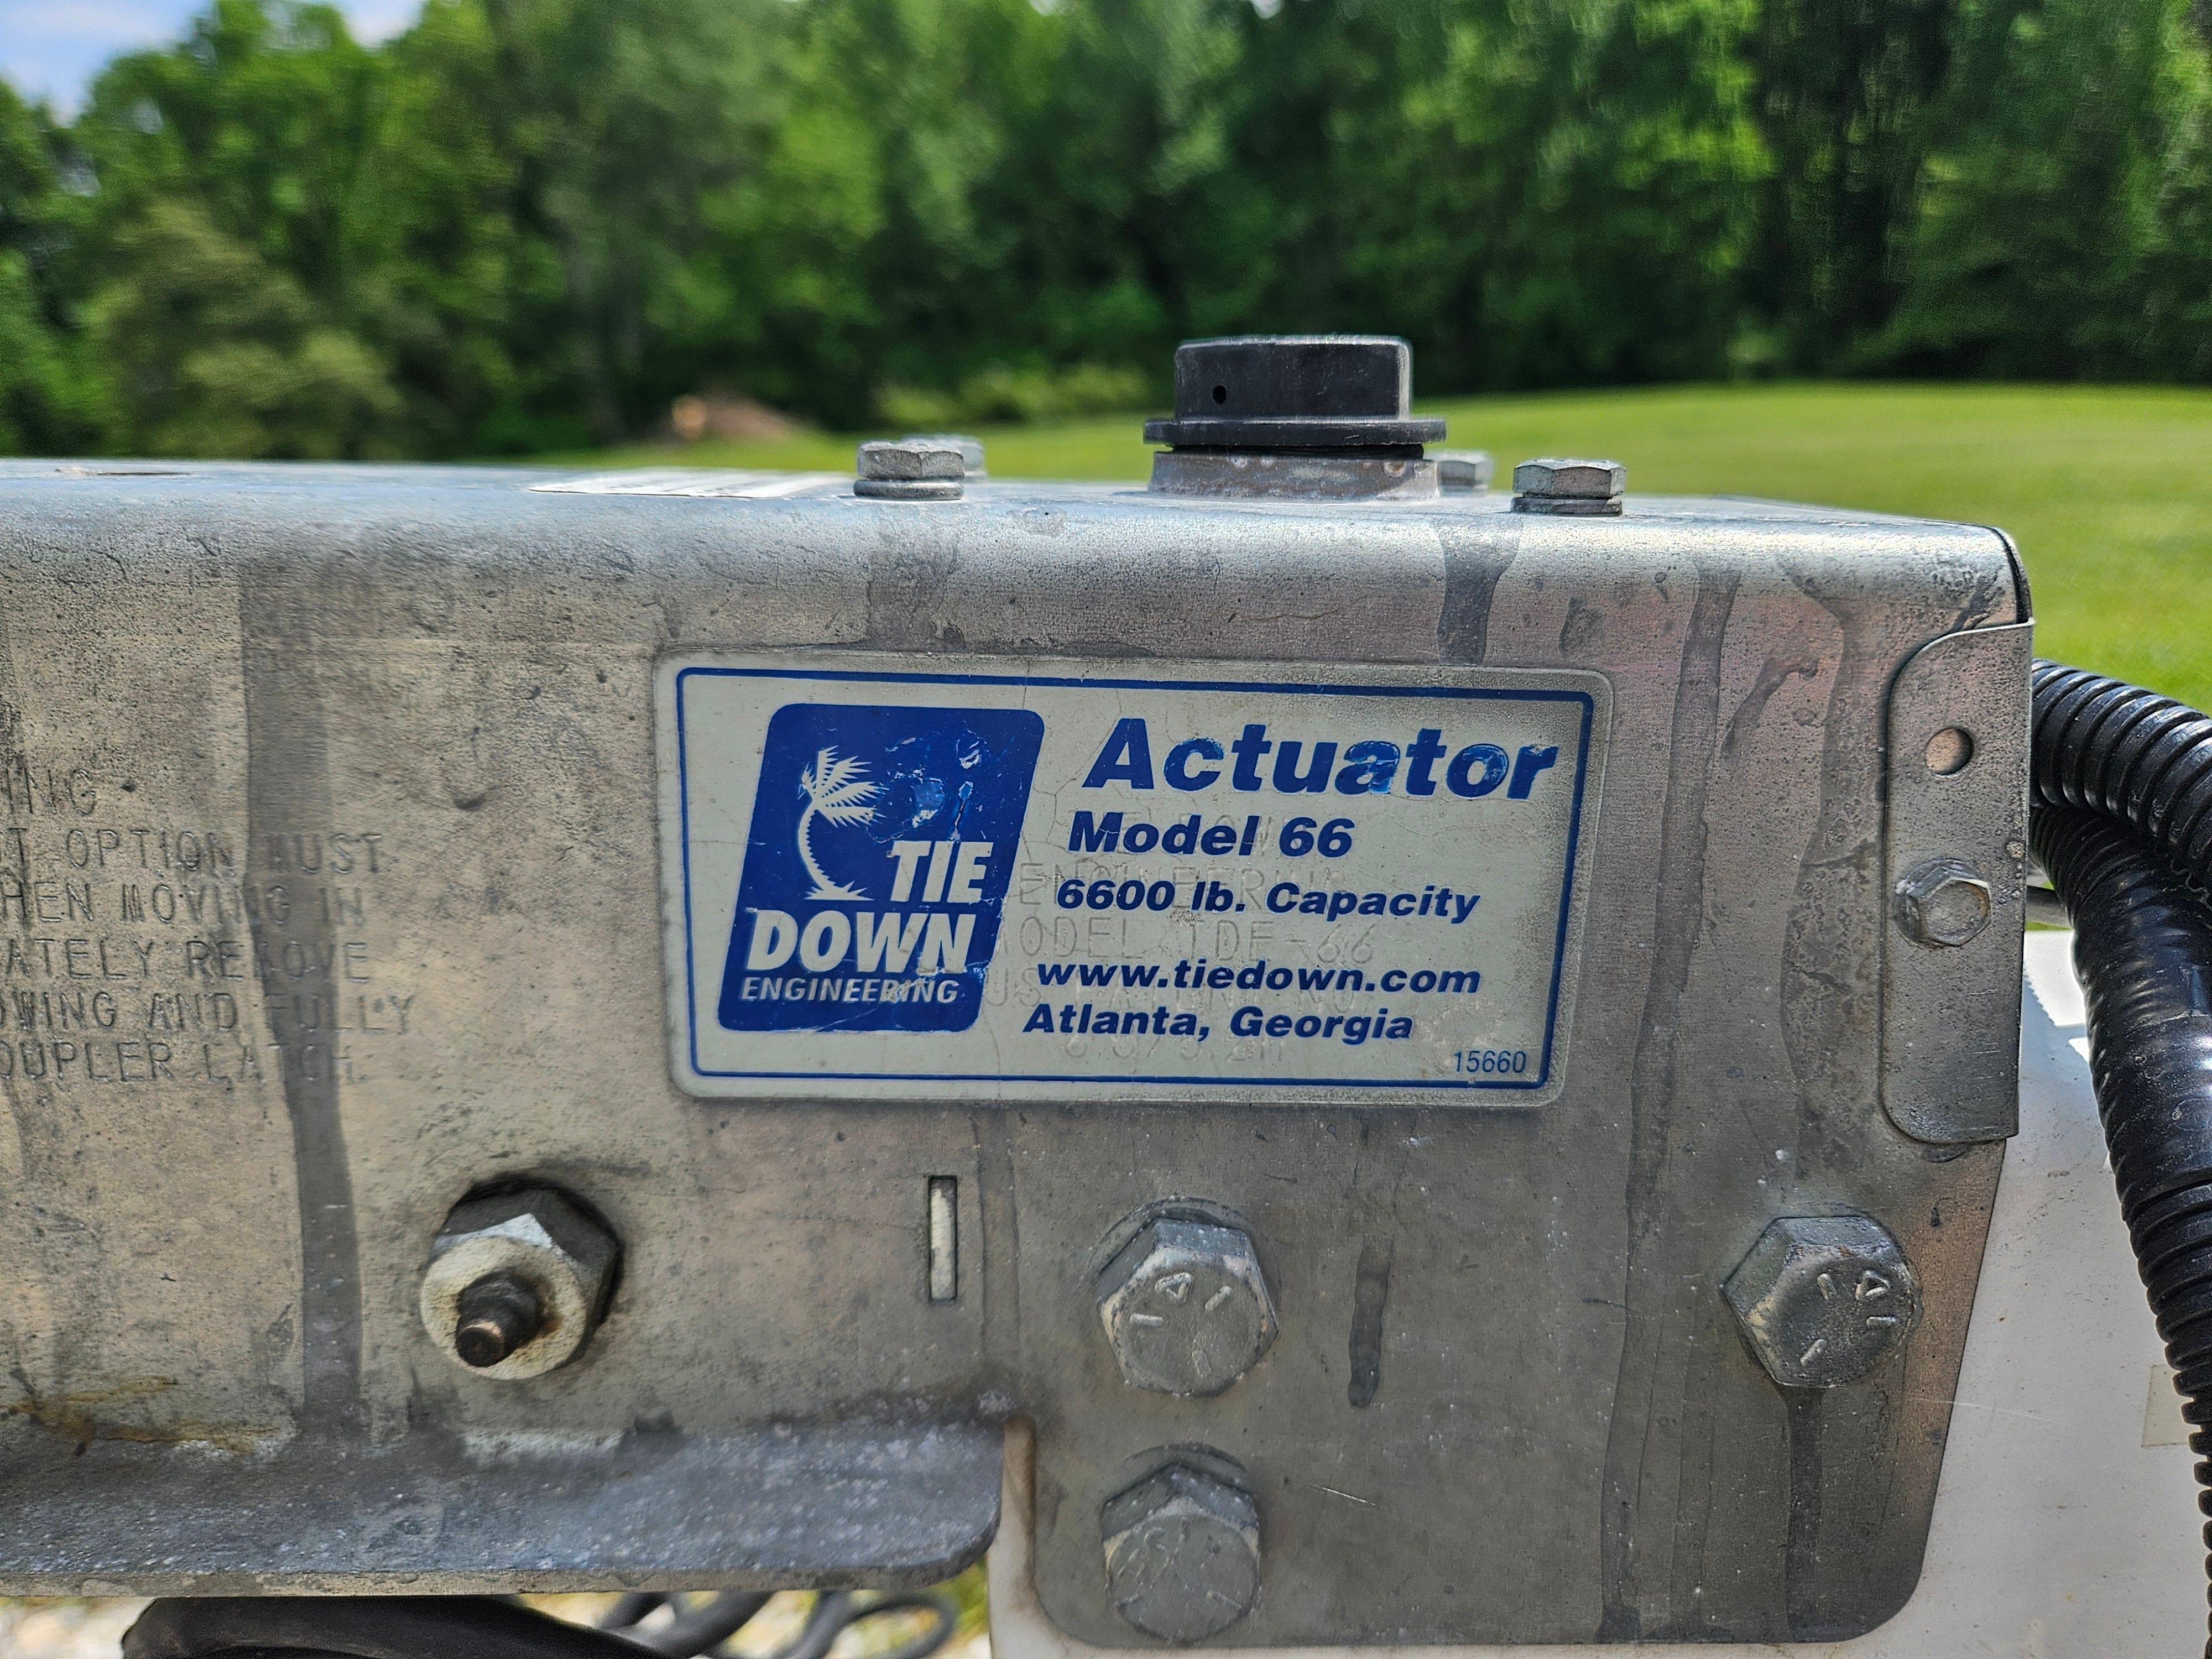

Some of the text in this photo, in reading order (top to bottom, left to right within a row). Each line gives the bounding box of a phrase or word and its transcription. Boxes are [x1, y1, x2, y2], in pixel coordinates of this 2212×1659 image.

[1082, 717, 1558, 800] Actuator
[1068, 811, 1356, 858] Model 66
[890, 841, 993, 903] TIE
[1057, 878, 1481, 925] 6600 lb. Capacity
[745, 910, 977, 974] DOWN
[741, 977, 959, 1003] ENGINEERING
[1037, 958, 1481, 994] www.tiedown.com
[1022, 1003, 1210, 1042] Atlanta,
[1229, 1006, 1413, 1046] Georgia
[1454, 1050, 1527, 1073] 15660
